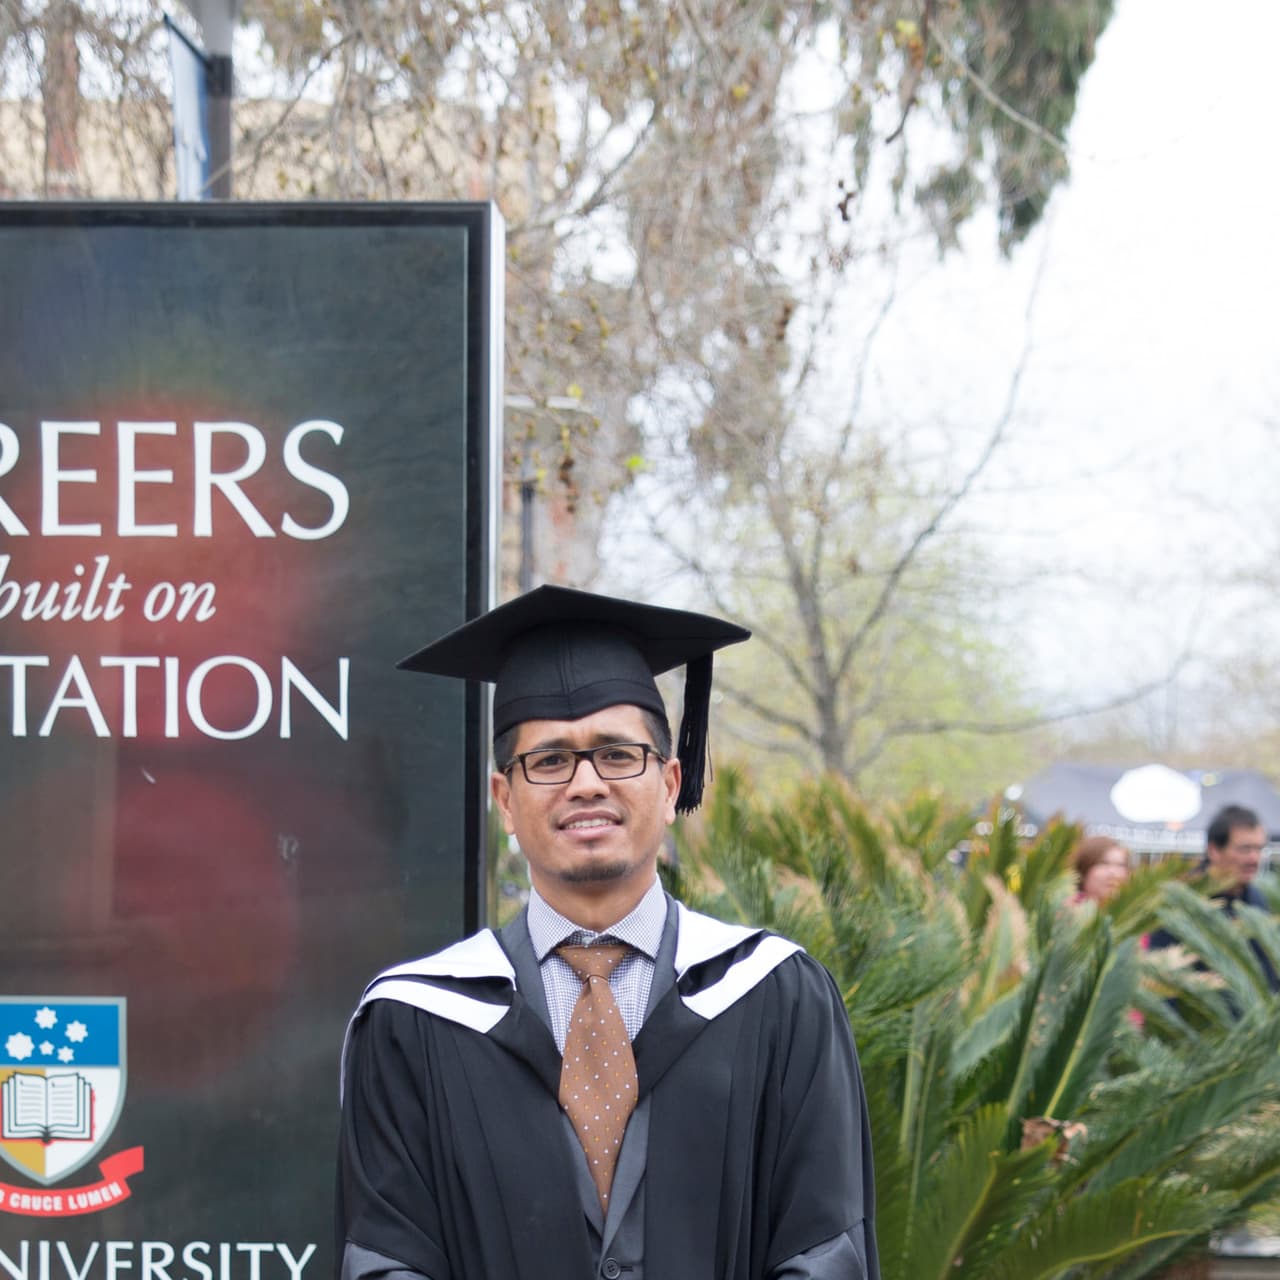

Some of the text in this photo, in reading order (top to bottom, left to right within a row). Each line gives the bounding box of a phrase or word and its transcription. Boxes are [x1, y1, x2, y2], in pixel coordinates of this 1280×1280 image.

[143, 580, 218, 622] on
[9, 1192, 63, 1212] CRUCE
[68, 1181, 123, 1210] LUMEN
